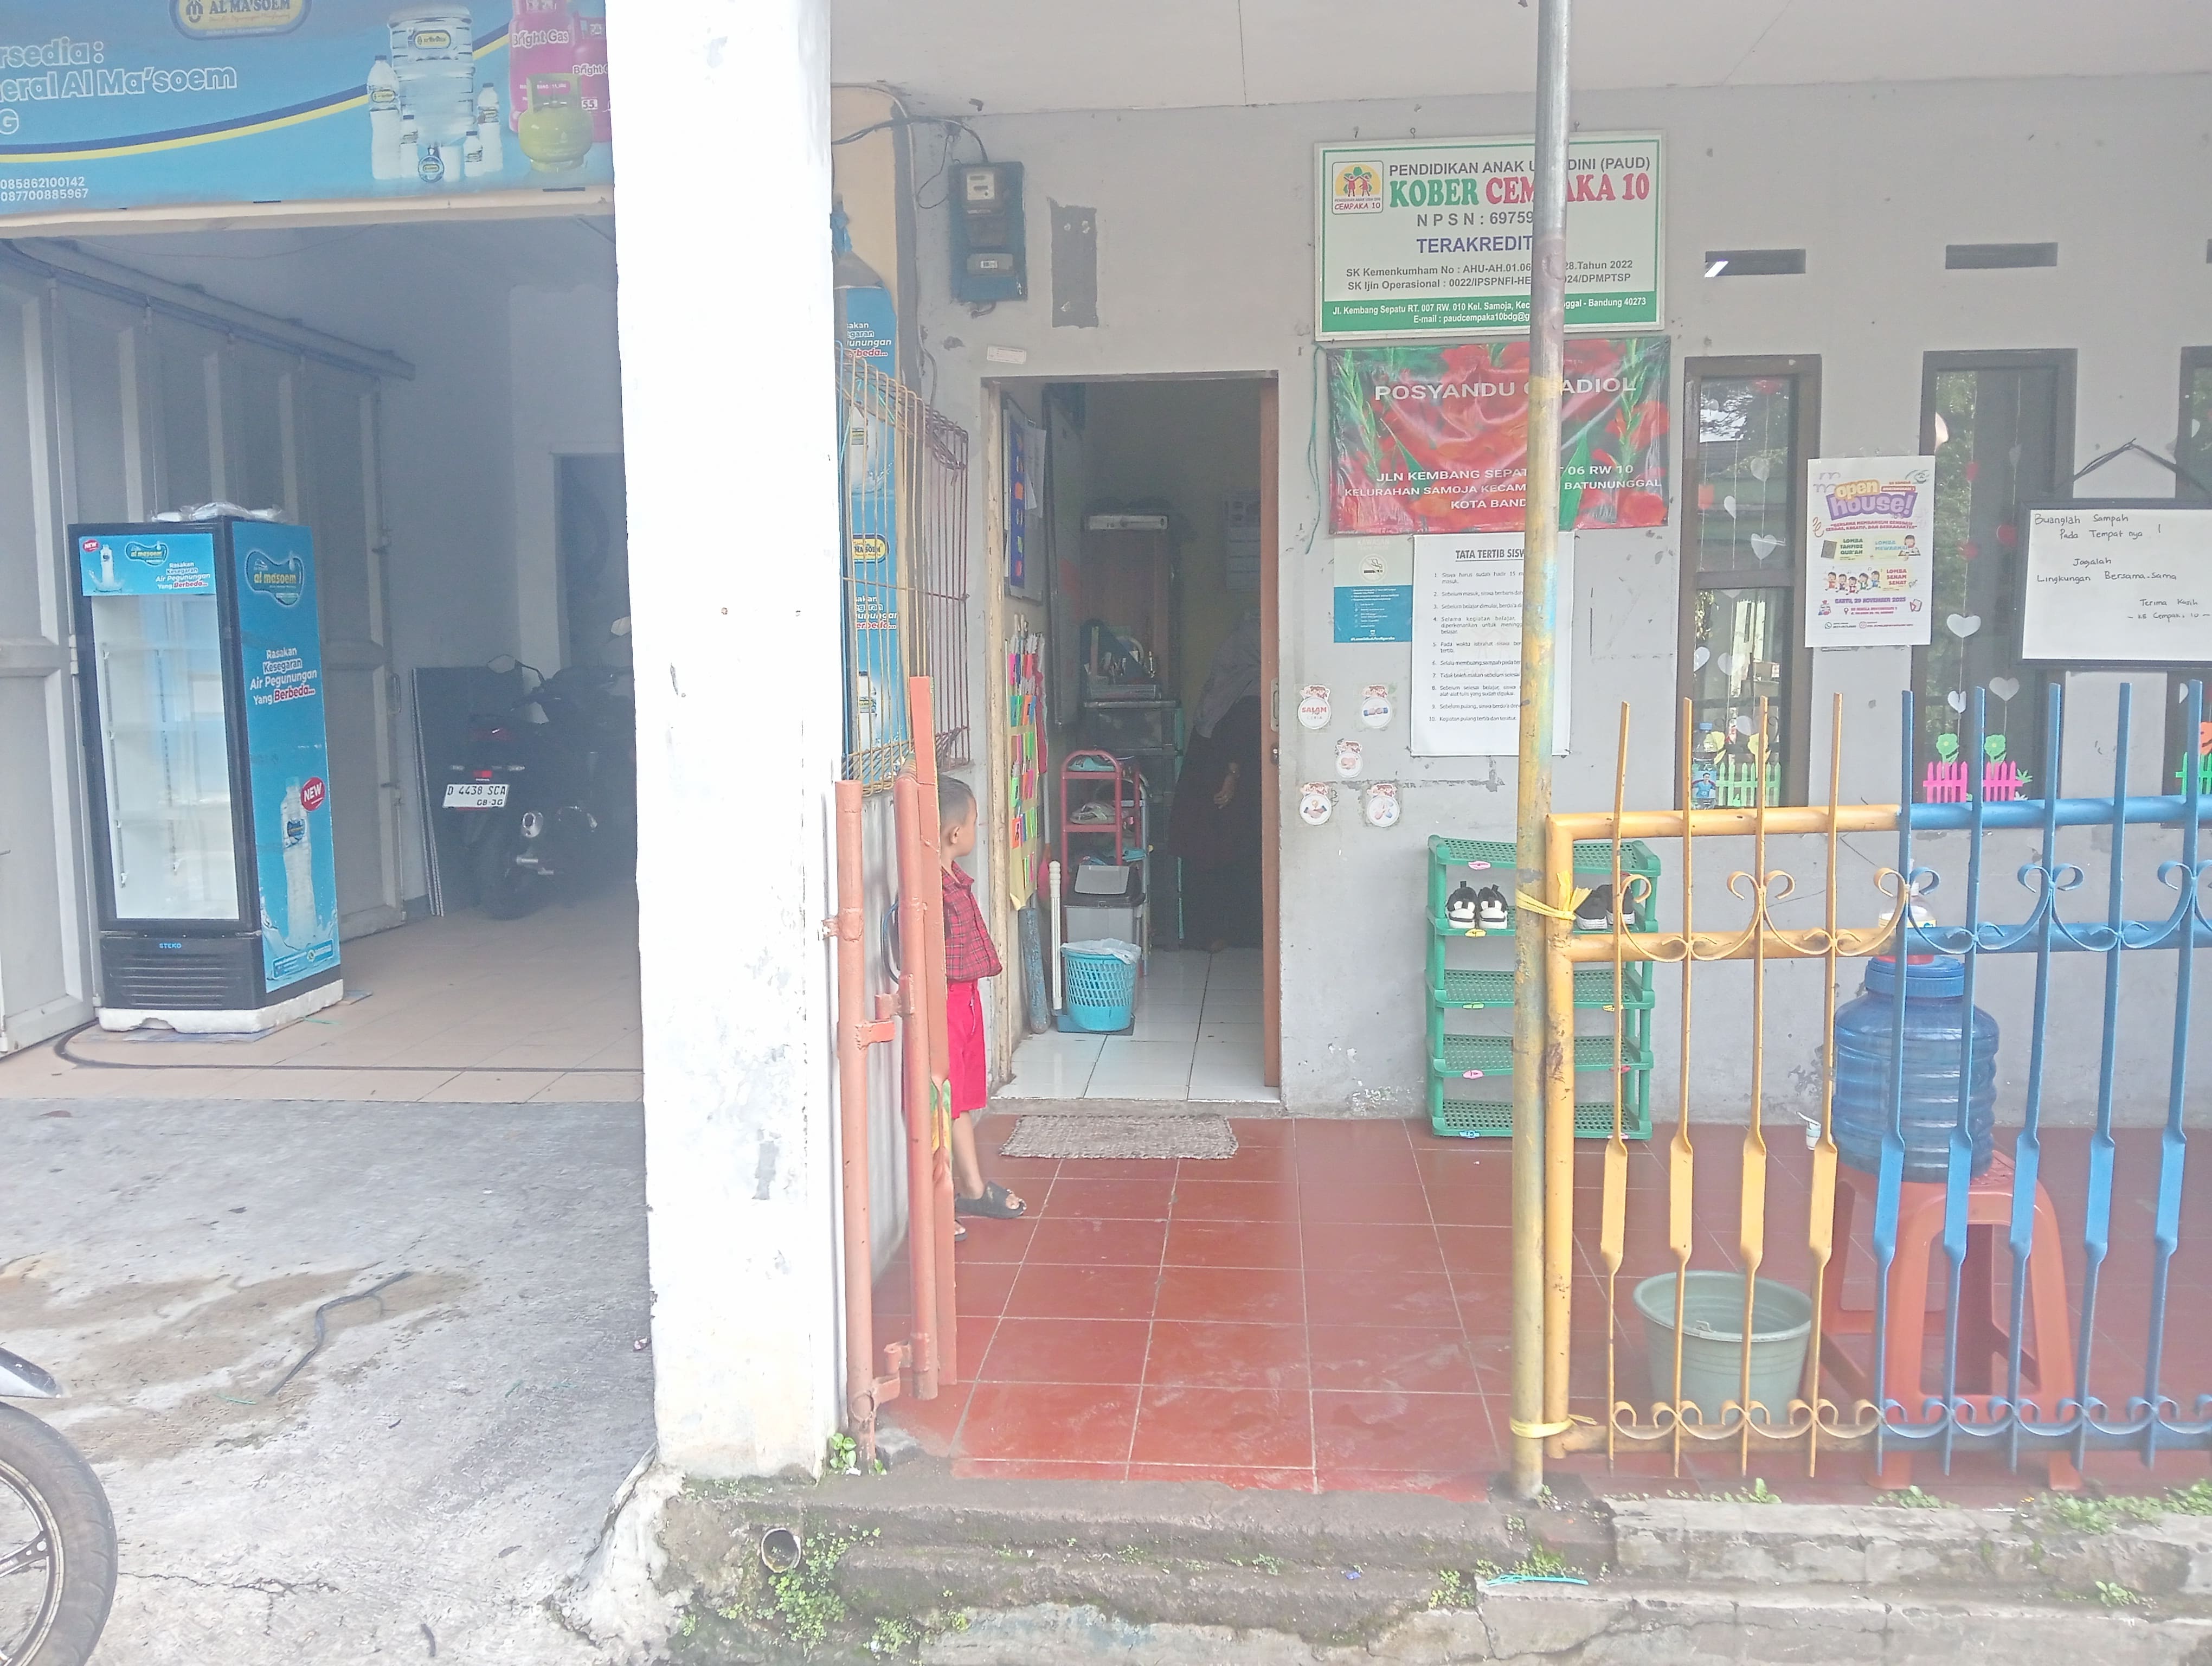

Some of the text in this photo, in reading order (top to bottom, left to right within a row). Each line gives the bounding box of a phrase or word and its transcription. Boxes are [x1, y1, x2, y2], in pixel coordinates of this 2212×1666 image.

[512, 29, 569, 48] Bright Gas
[573, 63, 603, 76] Bright
[0, 66, 237, 102] eral Al Ma'soem
[1390, 162, 1478, 176] PENDIDIKAN
[1482, 161, 1525, 173] ANAK
[1568, 158, 1596, 170] DINI
[1601, 157, 1650, 172] (PAUD)
[1, 176, 85, 189] 085862100142
[1, 188, 89, 202] 087700885967
[1390, 172, 1650, 208] KOBER CEMKA 10
[1490, 212, 1534, 224] 69759
[1416, 235, 1533, 253] TERAKREDIT
[1346, 260, 1633, 277] SK Kemenkumham No 2022
[1348, 281, 1361, 290] SK
[1382, 279, 1440, 291] Operasional
[1343, 304, 1378, 316] Kembang
[1380, 304, 1406, 314] Sepatu
[1421, 303, 1434, 312] 007
[1436, 303, 1451, 311] RW.
[1452, 303, 1466, 311] 010
[1468, 302, 1482, 310] Kel.
[1484, 302, 1514, 311] Samoja,
[1589, 298, 1622, 308] Bandung
[1624, 297, 1647, 305] 40273
[1413, 312, 1530, 324] E-mail paudcempaka10bdg@g
[847, 339, 892, 348] unungan
[1374, 380, 1516, 401] POSYANDU
[1377, 464, 1634, 481] JLN KEMBANG SEPAT 06 RW 10
[1345, 479, 1662, 497] KELURAHAN SAMOJA KECAM BATUNUNGGAL
[1836, 479, 1878, 499] open
[1451, 498, 1527, 510] KOTA BAND
[1829, 494, 1914, 517] house!
[2035, 513, 2129, 527] Buanglah Sampah
[2060, 529, 2143, 541] Pada Tempat nya
[1455, 550, 1475, 559] TATA
[1477, 549, 1504, 559] TERTIB
[2073, 558, 2112, 568] Jagalah
[167, 573, 210, 582] Pegunungan
[2037, 575, 2091, 585] Lingkungan
[2139, 598, 2168, 606] Terima
[266, 647, 297, 659] Rasakan
[263, 658, 302, 674] Kesegaran
[250, 670, 317, 690] Air Pegunungan
[253, 694, 272, 705] Yang
[304, 782, 322, 802] NEW
[447, 786, 506, 796] D 4438 SCA
